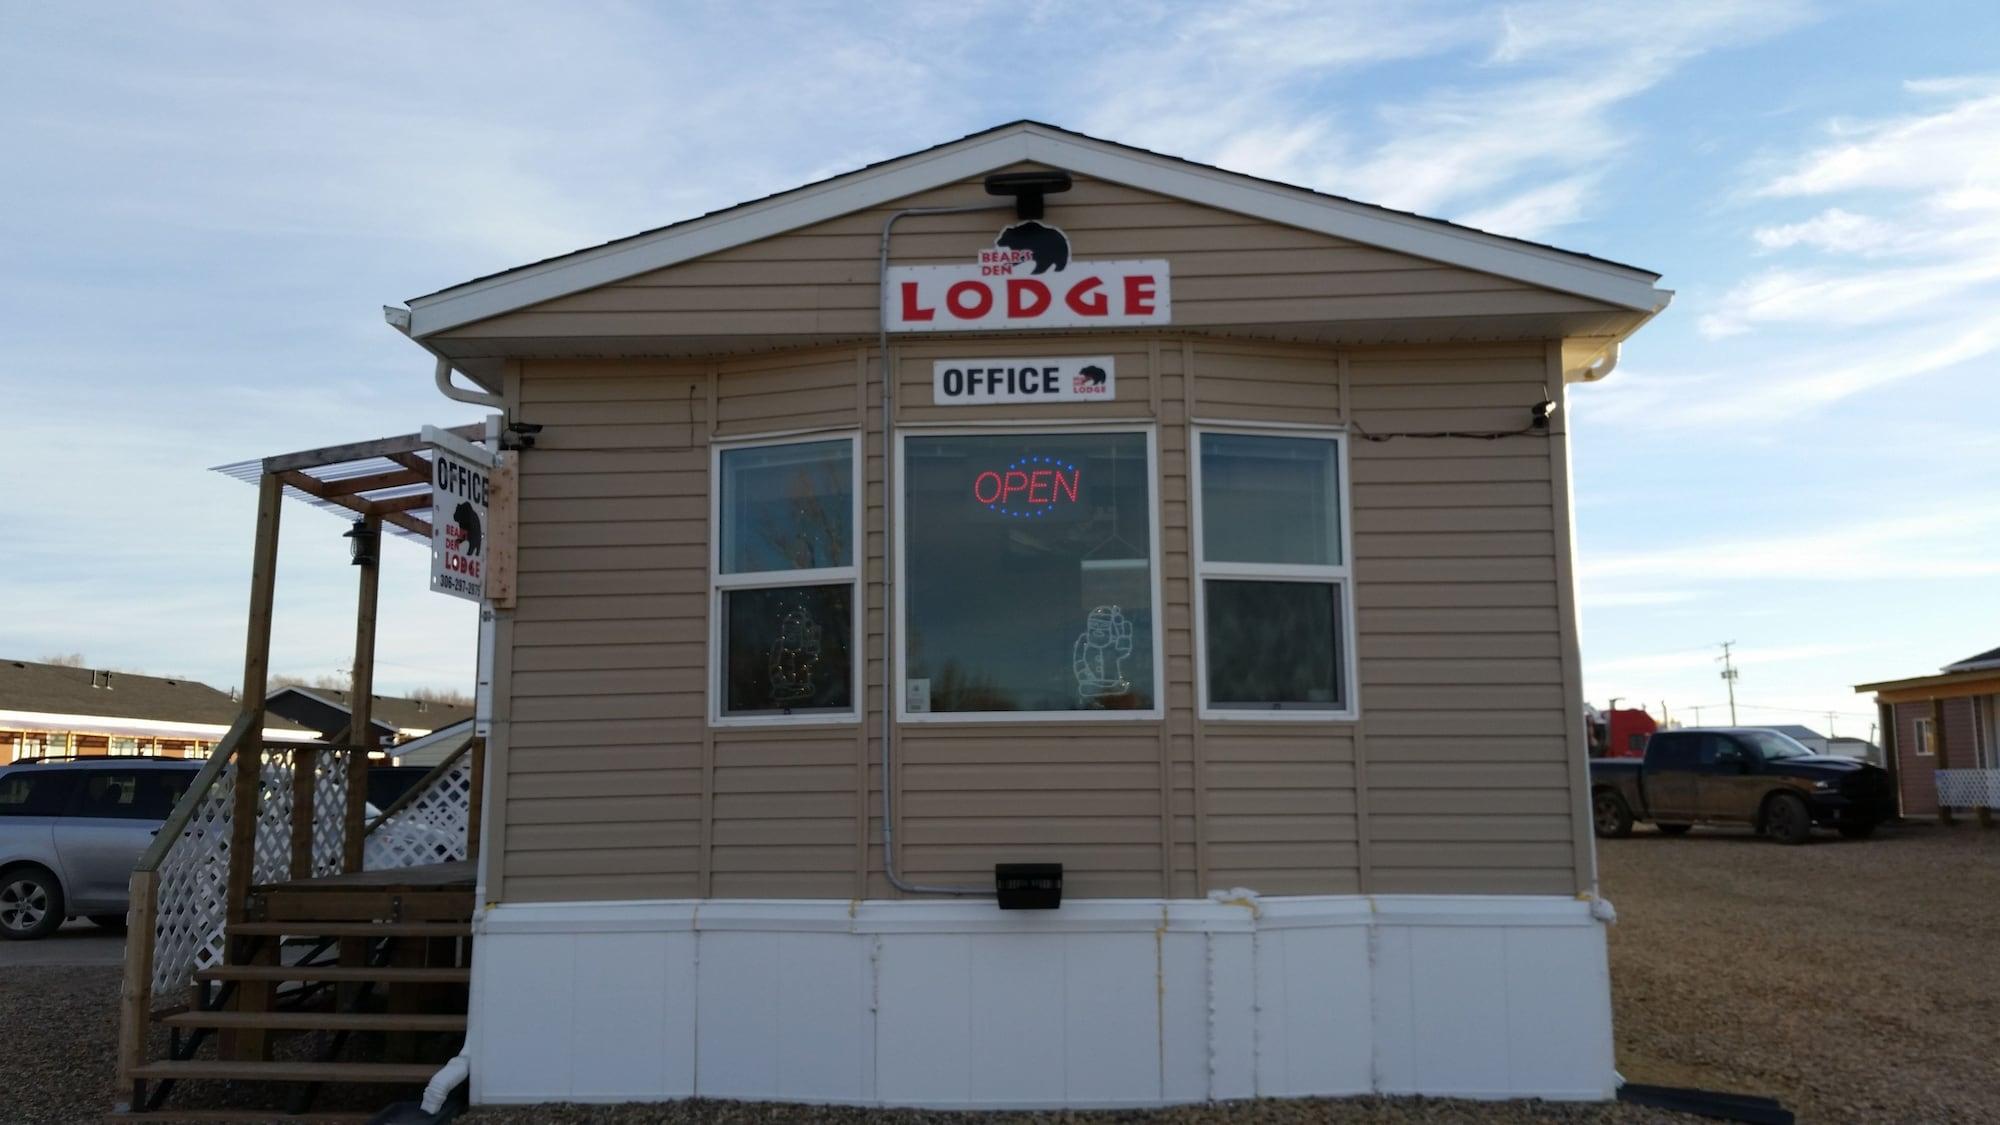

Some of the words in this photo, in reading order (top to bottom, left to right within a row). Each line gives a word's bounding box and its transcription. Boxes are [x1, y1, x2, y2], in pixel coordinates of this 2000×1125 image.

[981, 250, 1033, 263] BEAR'S
[981, 265, 1012, 276] DEN
[901, 275, 1156, 322] LODGE
[943, 367, 1060, 396] OFFICE
[437, 456, 490, 509] OFFICE
[975, 469, 1080, 503] OPEN
[445, 551, 481, 578] LODGE
